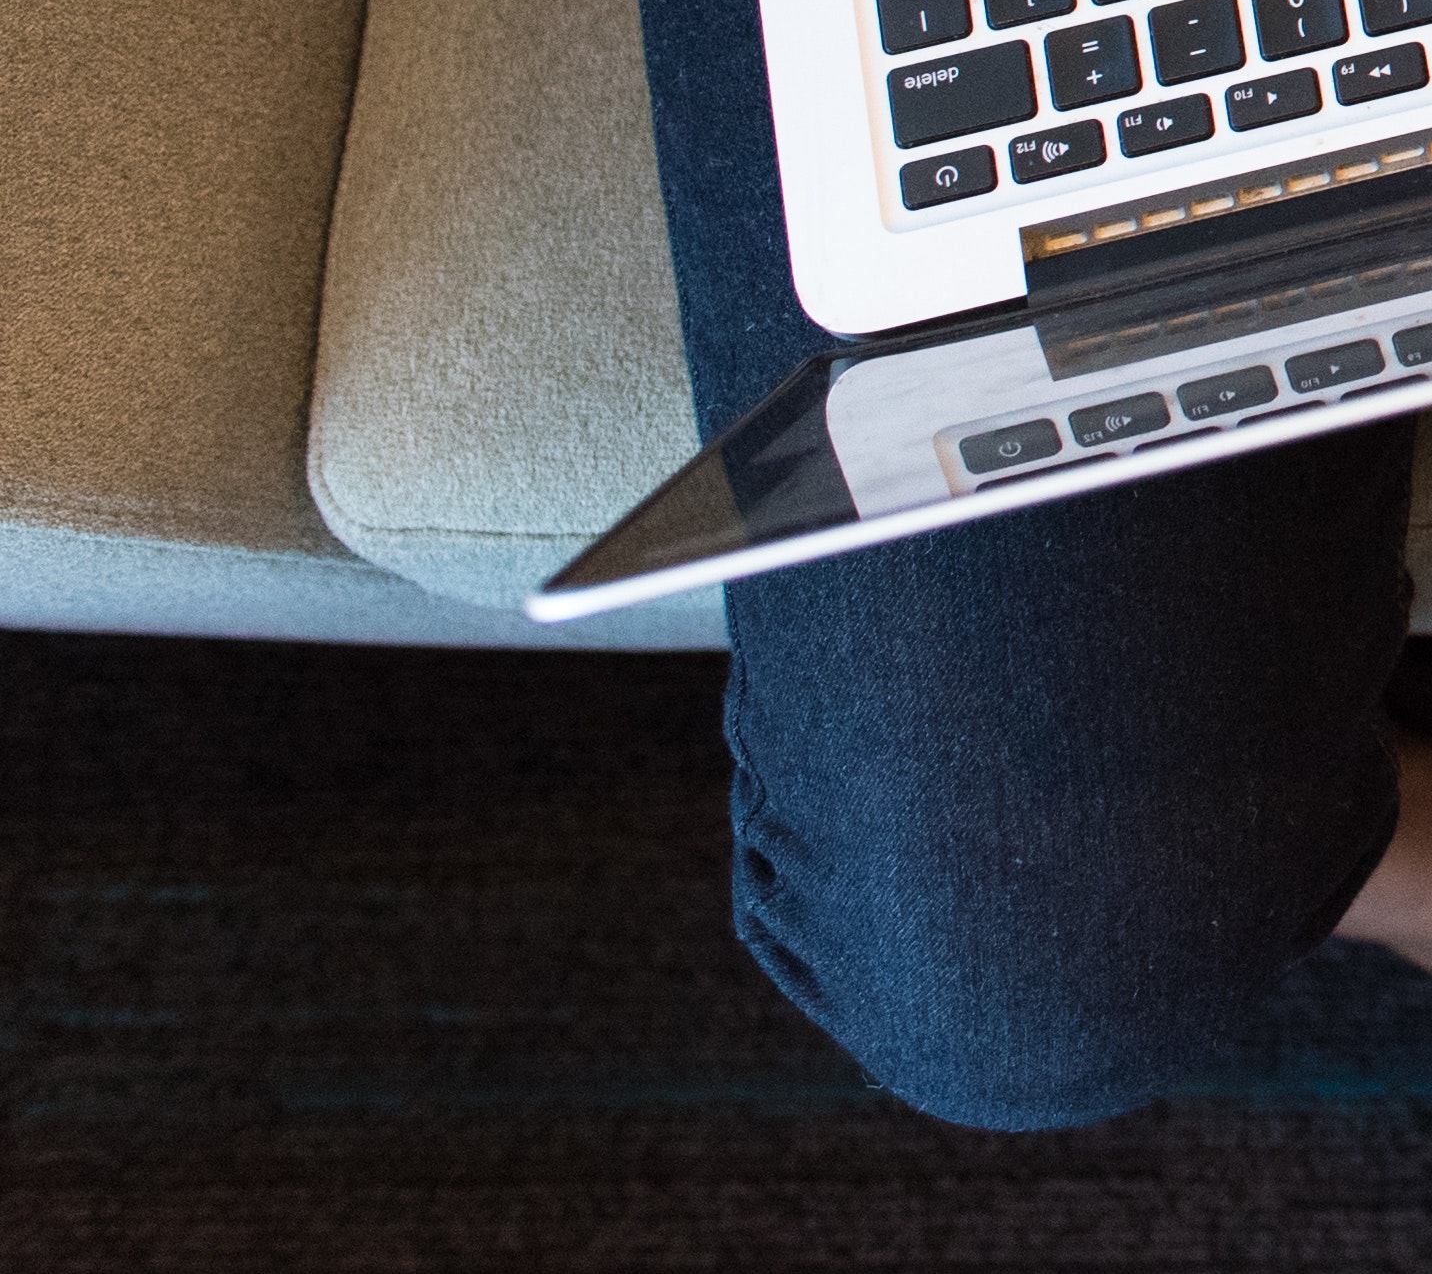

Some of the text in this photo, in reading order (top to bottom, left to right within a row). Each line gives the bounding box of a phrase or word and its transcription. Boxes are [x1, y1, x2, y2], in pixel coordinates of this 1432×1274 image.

[1341, 63, 1354, 75] F9
[904, 66, 959, 89] delete
[1234, 88, 1253, 100] F10
[1124, 115, 1142, 127] F11
[1016, 141, 1036, 154] F12
